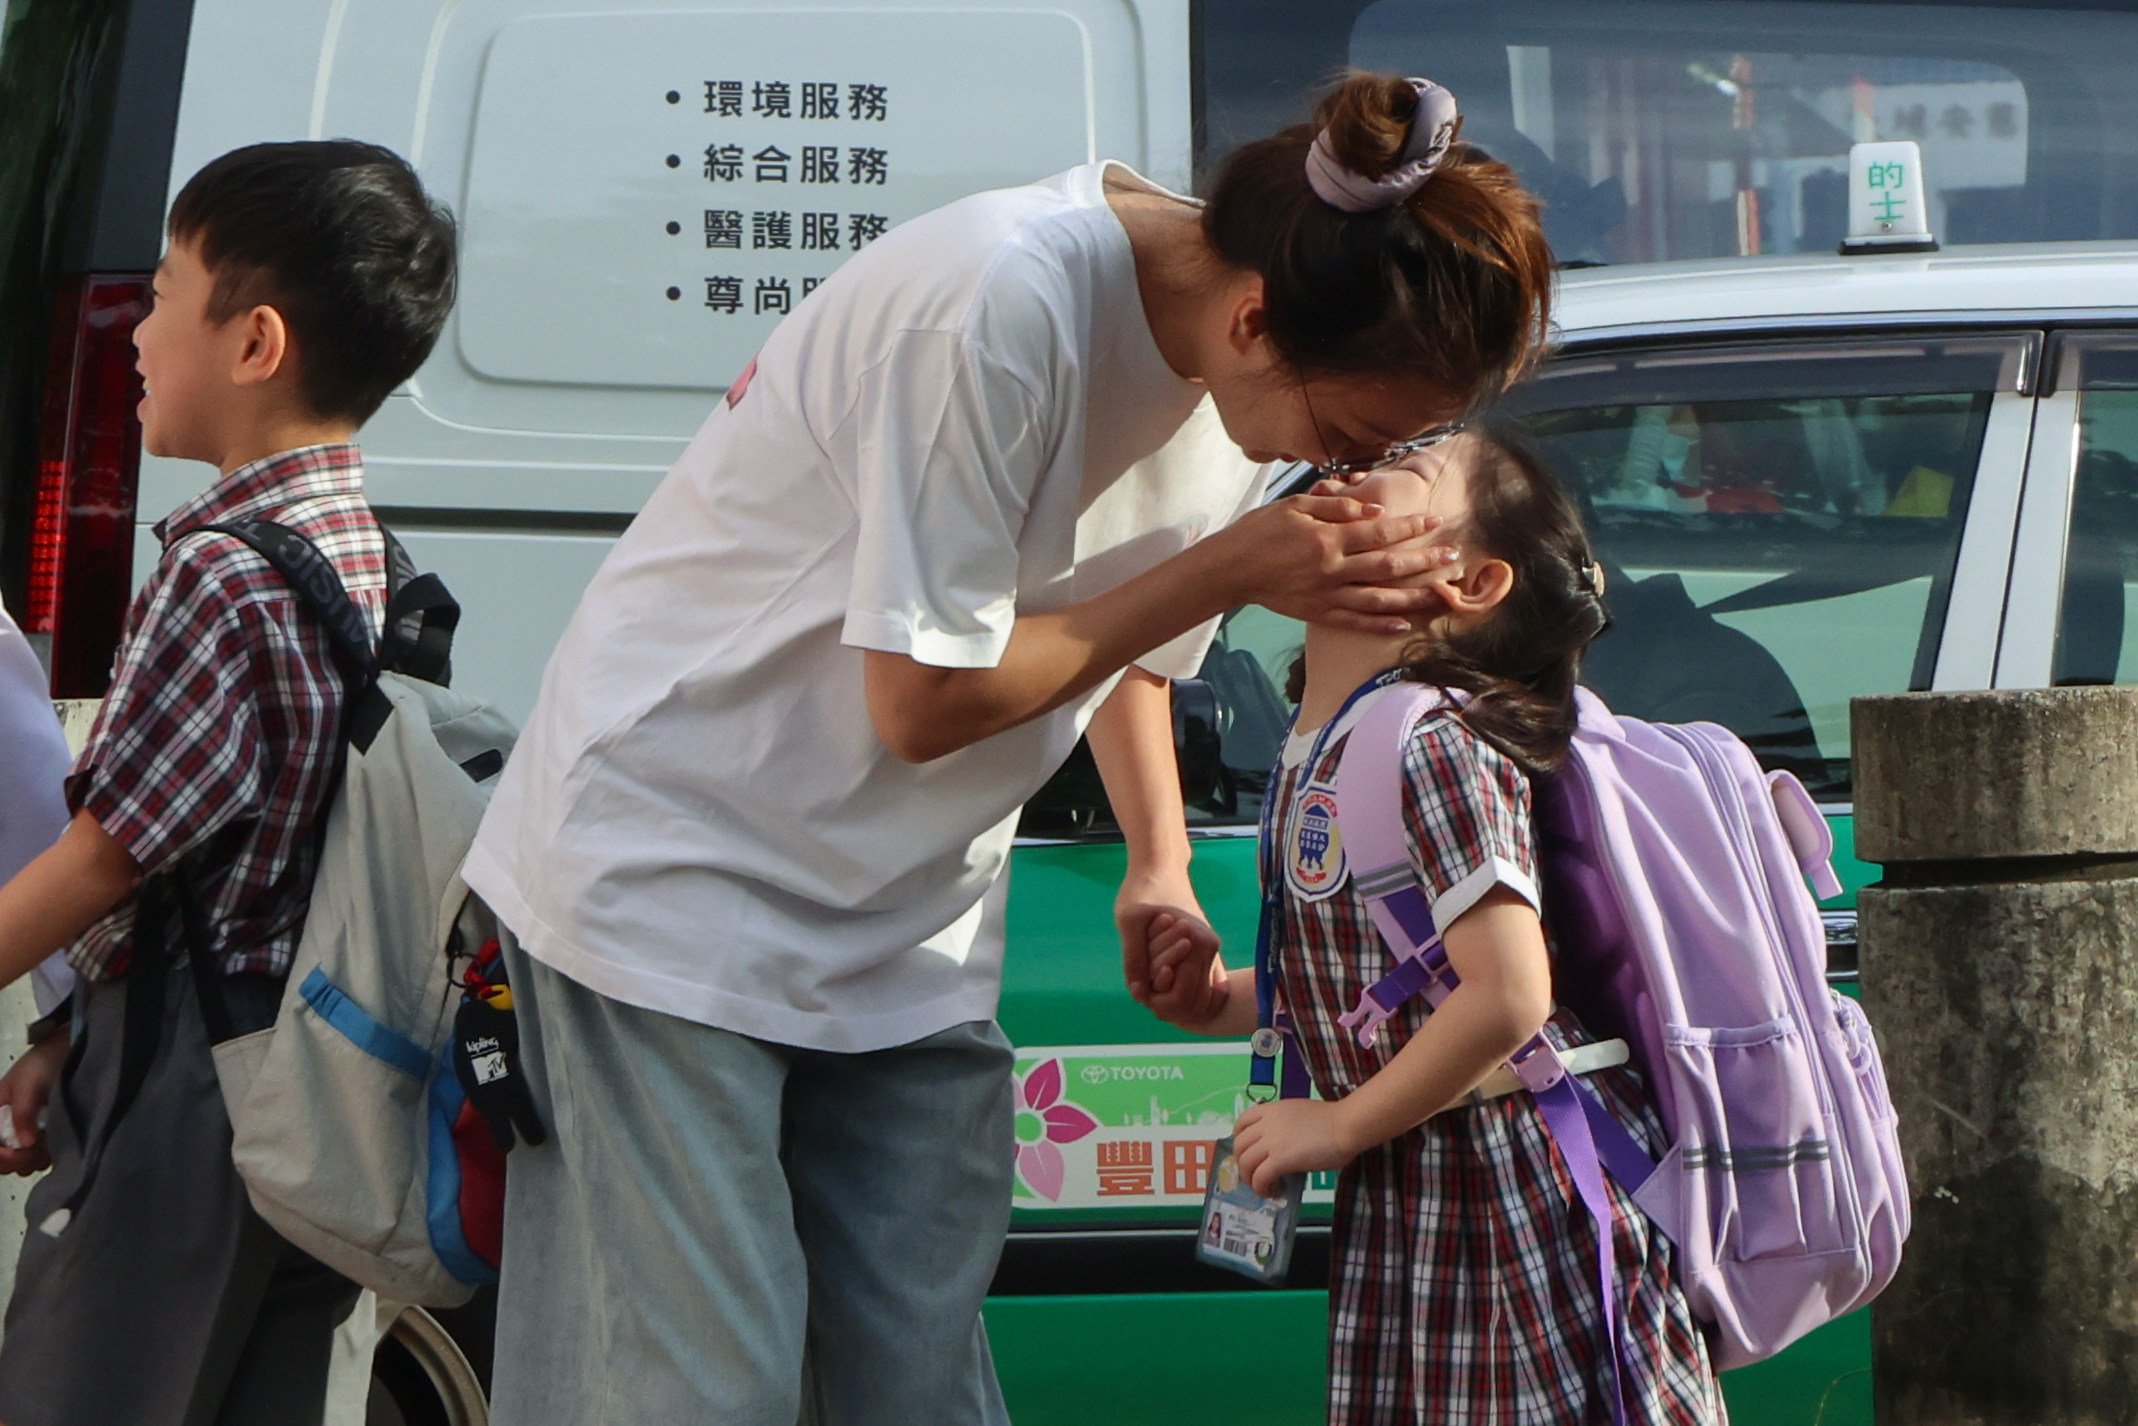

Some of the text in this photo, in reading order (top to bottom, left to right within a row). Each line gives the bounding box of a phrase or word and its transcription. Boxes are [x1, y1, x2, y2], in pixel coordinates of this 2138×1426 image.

[703, 80, 888, 122] 環境服務
[703, 143, 888, 186] 綜合服務
[1868, 161, 1906, 222] 的士
[703, 209, 888, 251] 醫護服務
[703, 275, 827, 316] 尊尚
[1110, 1066, 1184, 1081] TOYOTA
[1097, 1139, 1218, 1196] 豐田
